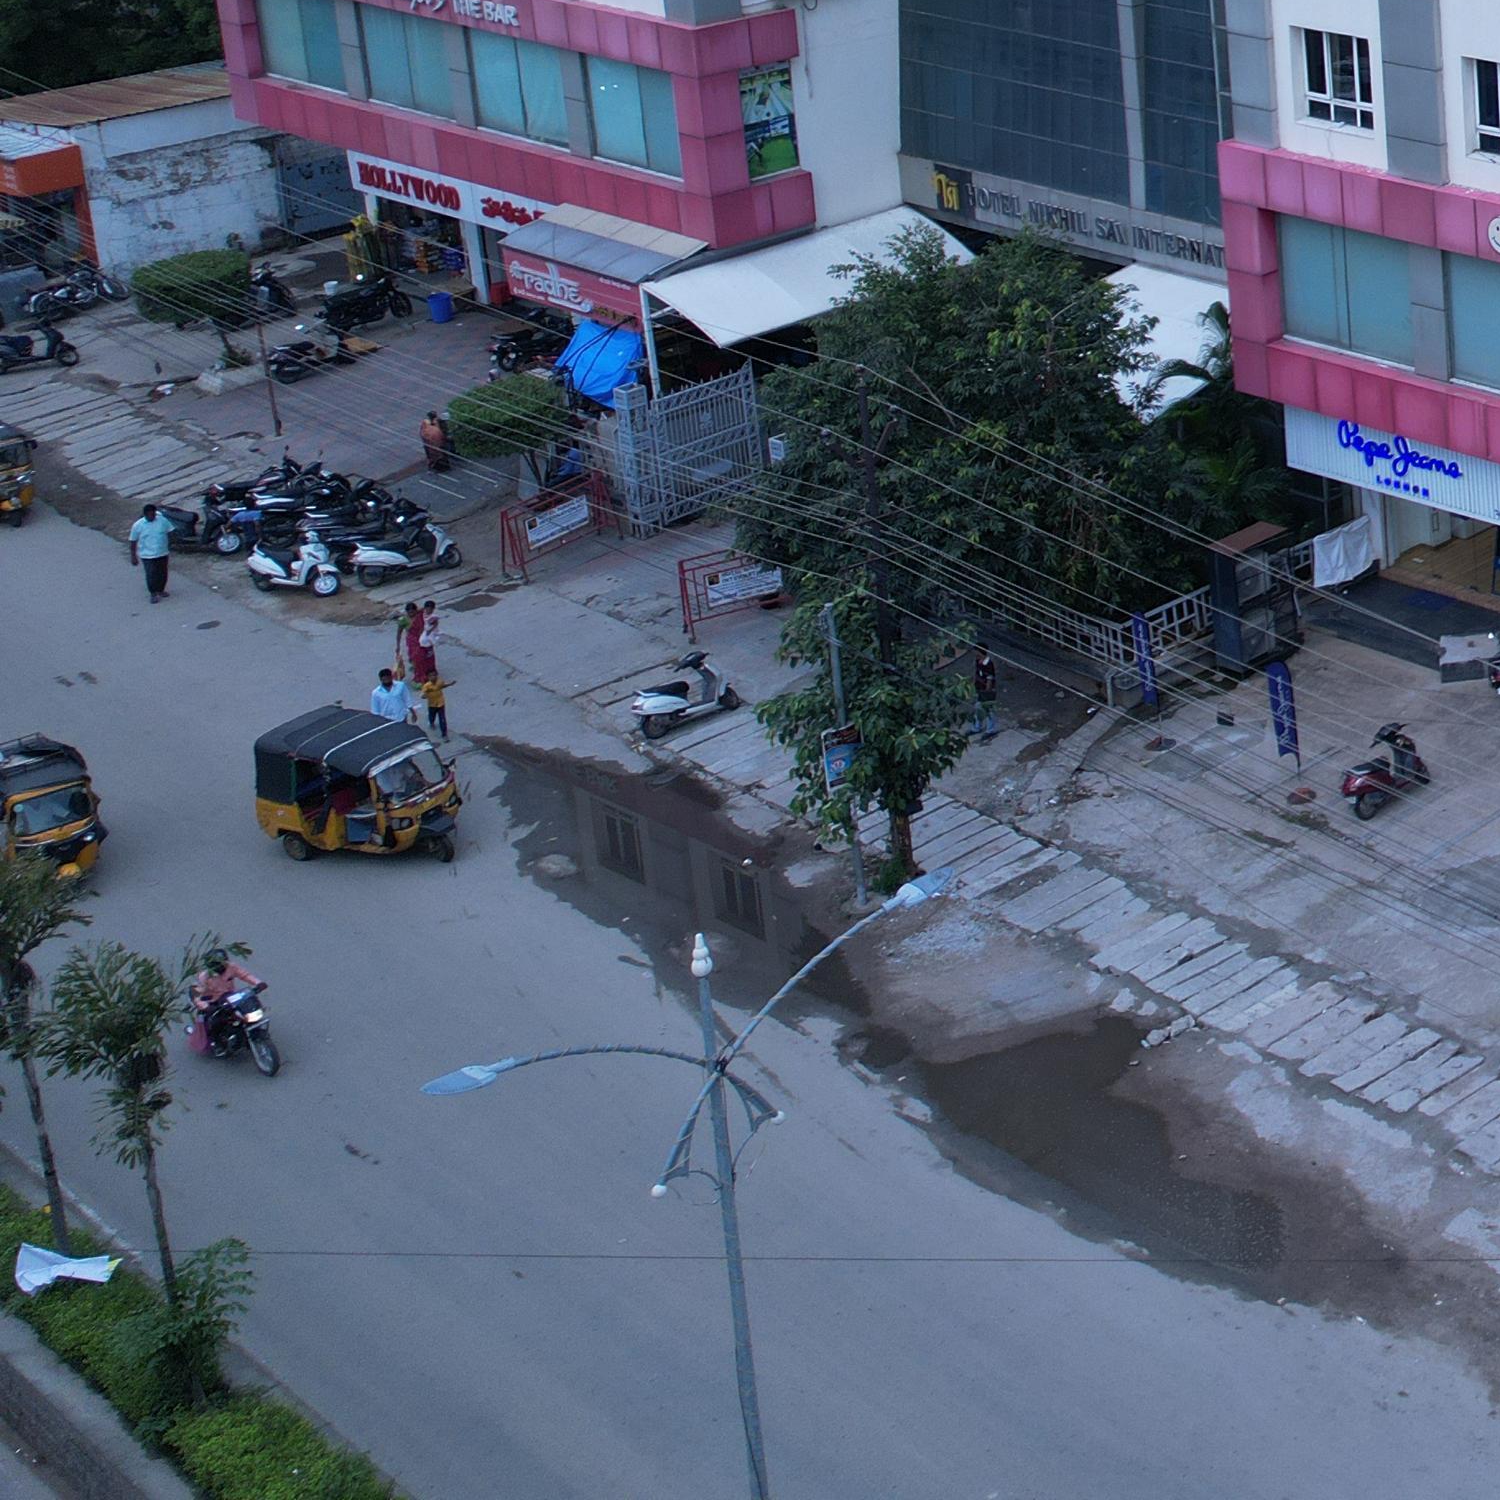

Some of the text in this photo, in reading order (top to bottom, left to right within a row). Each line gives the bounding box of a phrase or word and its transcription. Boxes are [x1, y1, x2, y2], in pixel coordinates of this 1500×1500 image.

[483, 1, 519, 27] BAR
[356, 161, 460, 211] HOLLYWOOD
[964, 182, 1023, 217] HOTEL
[1028, 199, 1089, 236] NIKHIL
[1337, 419, 1463, 477] Pepe Jeans
[1376, 474, 1430, 497] LONDON
